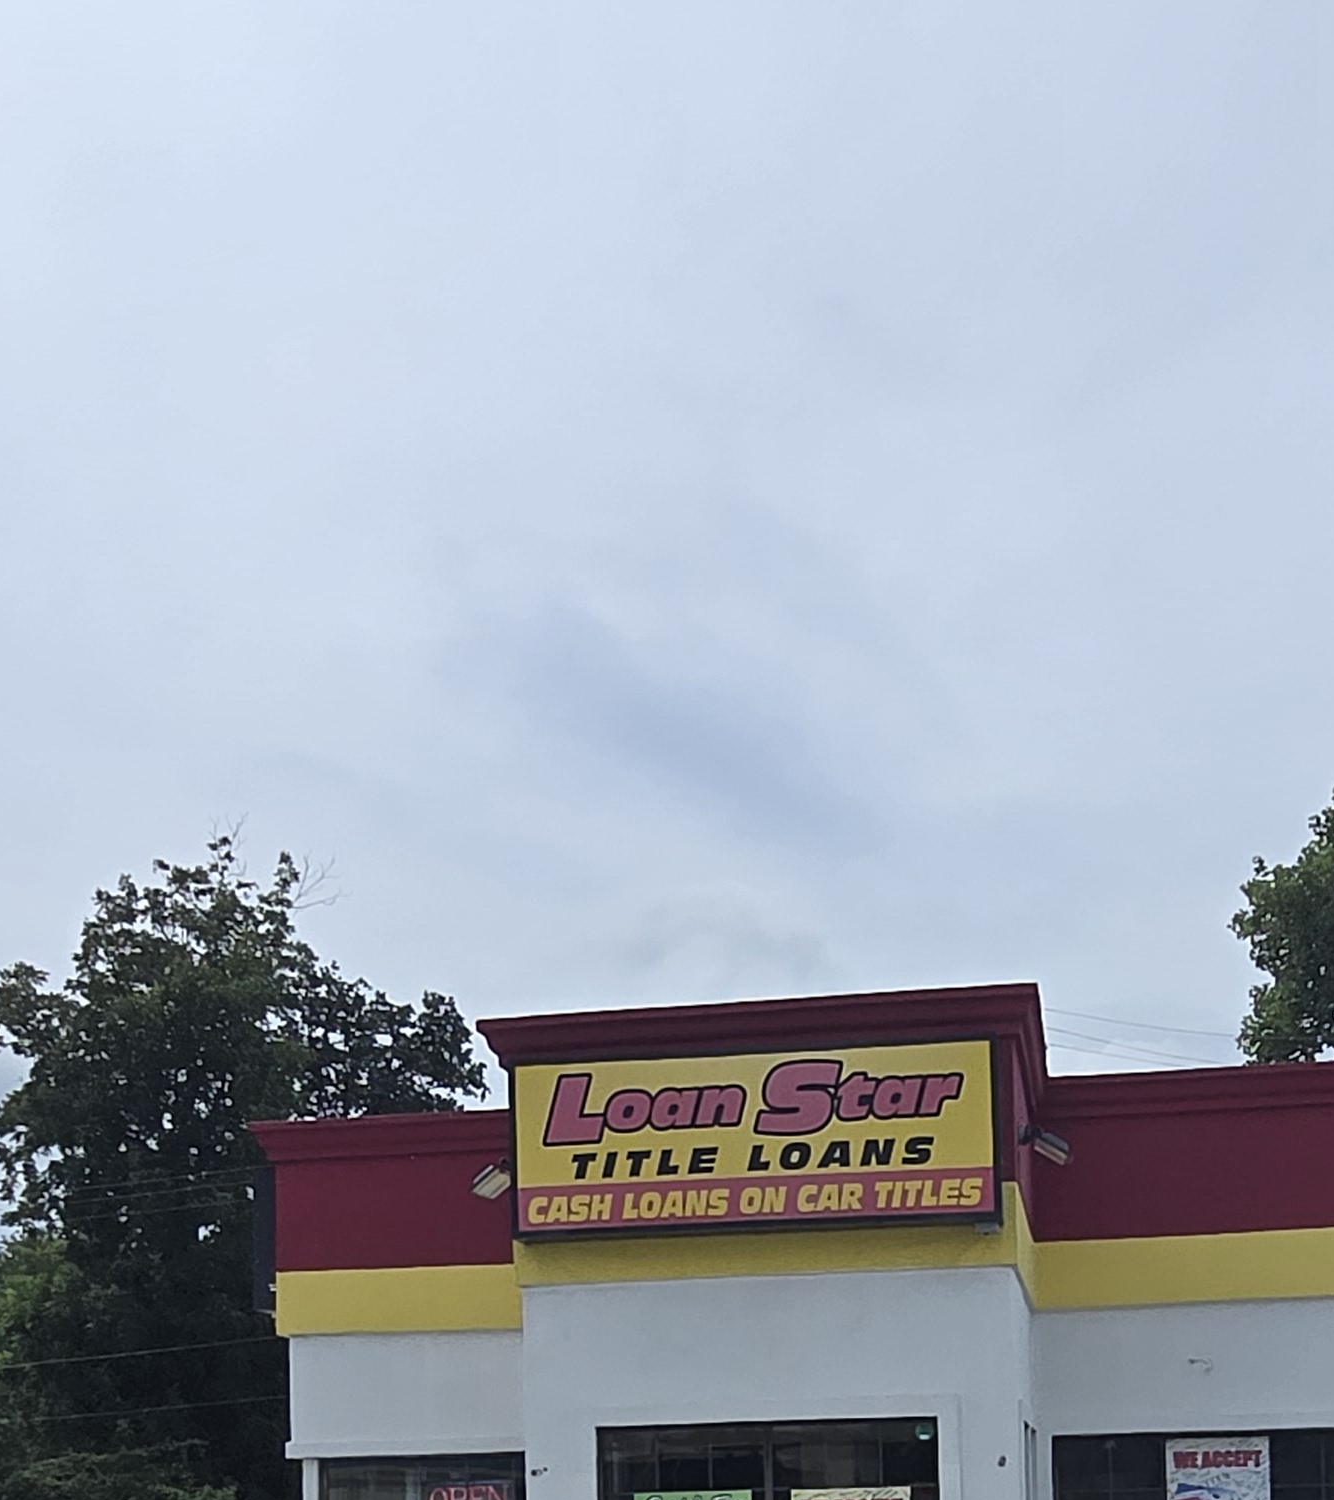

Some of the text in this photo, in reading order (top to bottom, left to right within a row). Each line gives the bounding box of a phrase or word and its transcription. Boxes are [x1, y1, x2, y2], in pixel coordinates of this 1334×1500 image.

[542, 1059, 962, 1147] Loan Star
[572, 1137, 934, 1179] TITLE LOANS
[527, 1178, 982, 1224] CASH LOANS ON CAR TITLES
[1173, 1450, 1262, 1468] WE ACCEPT
